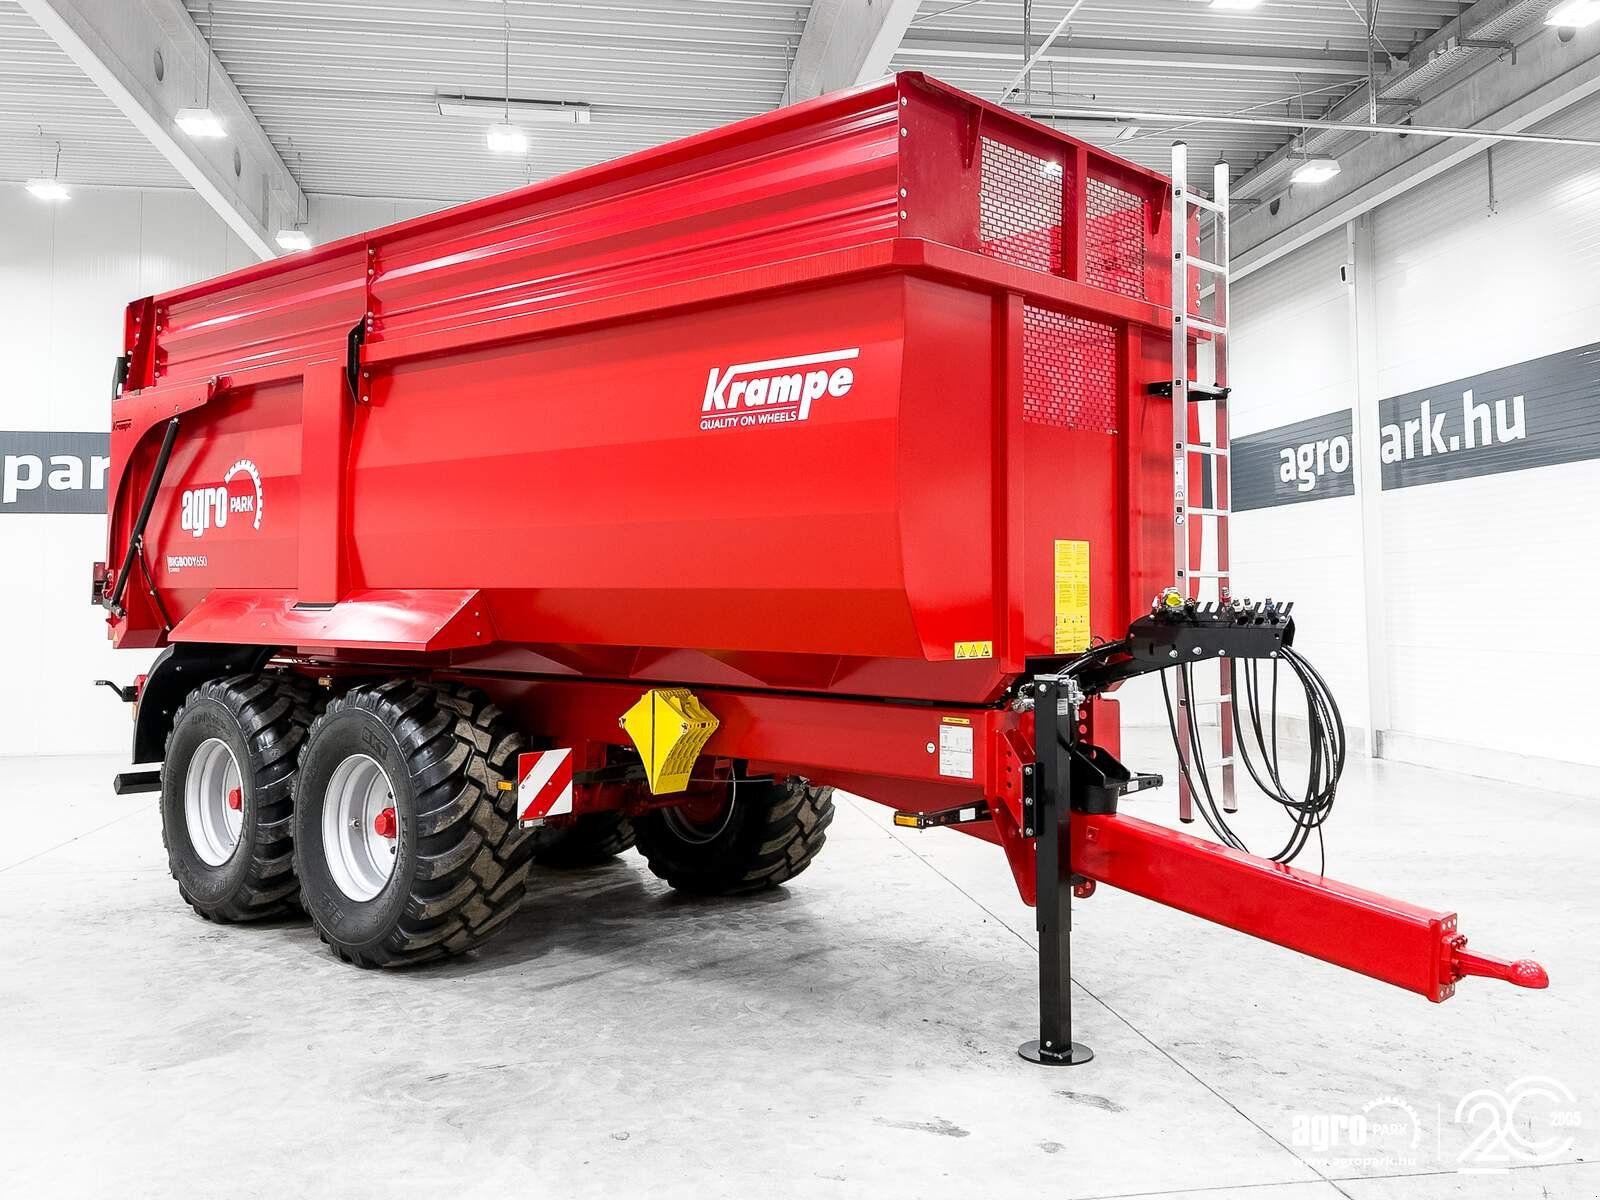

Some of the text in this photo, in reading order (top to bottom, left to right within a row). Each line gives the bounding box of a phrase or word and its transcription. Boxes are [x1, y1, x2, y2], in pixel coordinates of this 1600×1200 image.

[700, 348, 860, 421] Krampe
[700, 411, 797, 430] QUALITY ON WHEELS
[181, 486, 254, 538] agro PARK
